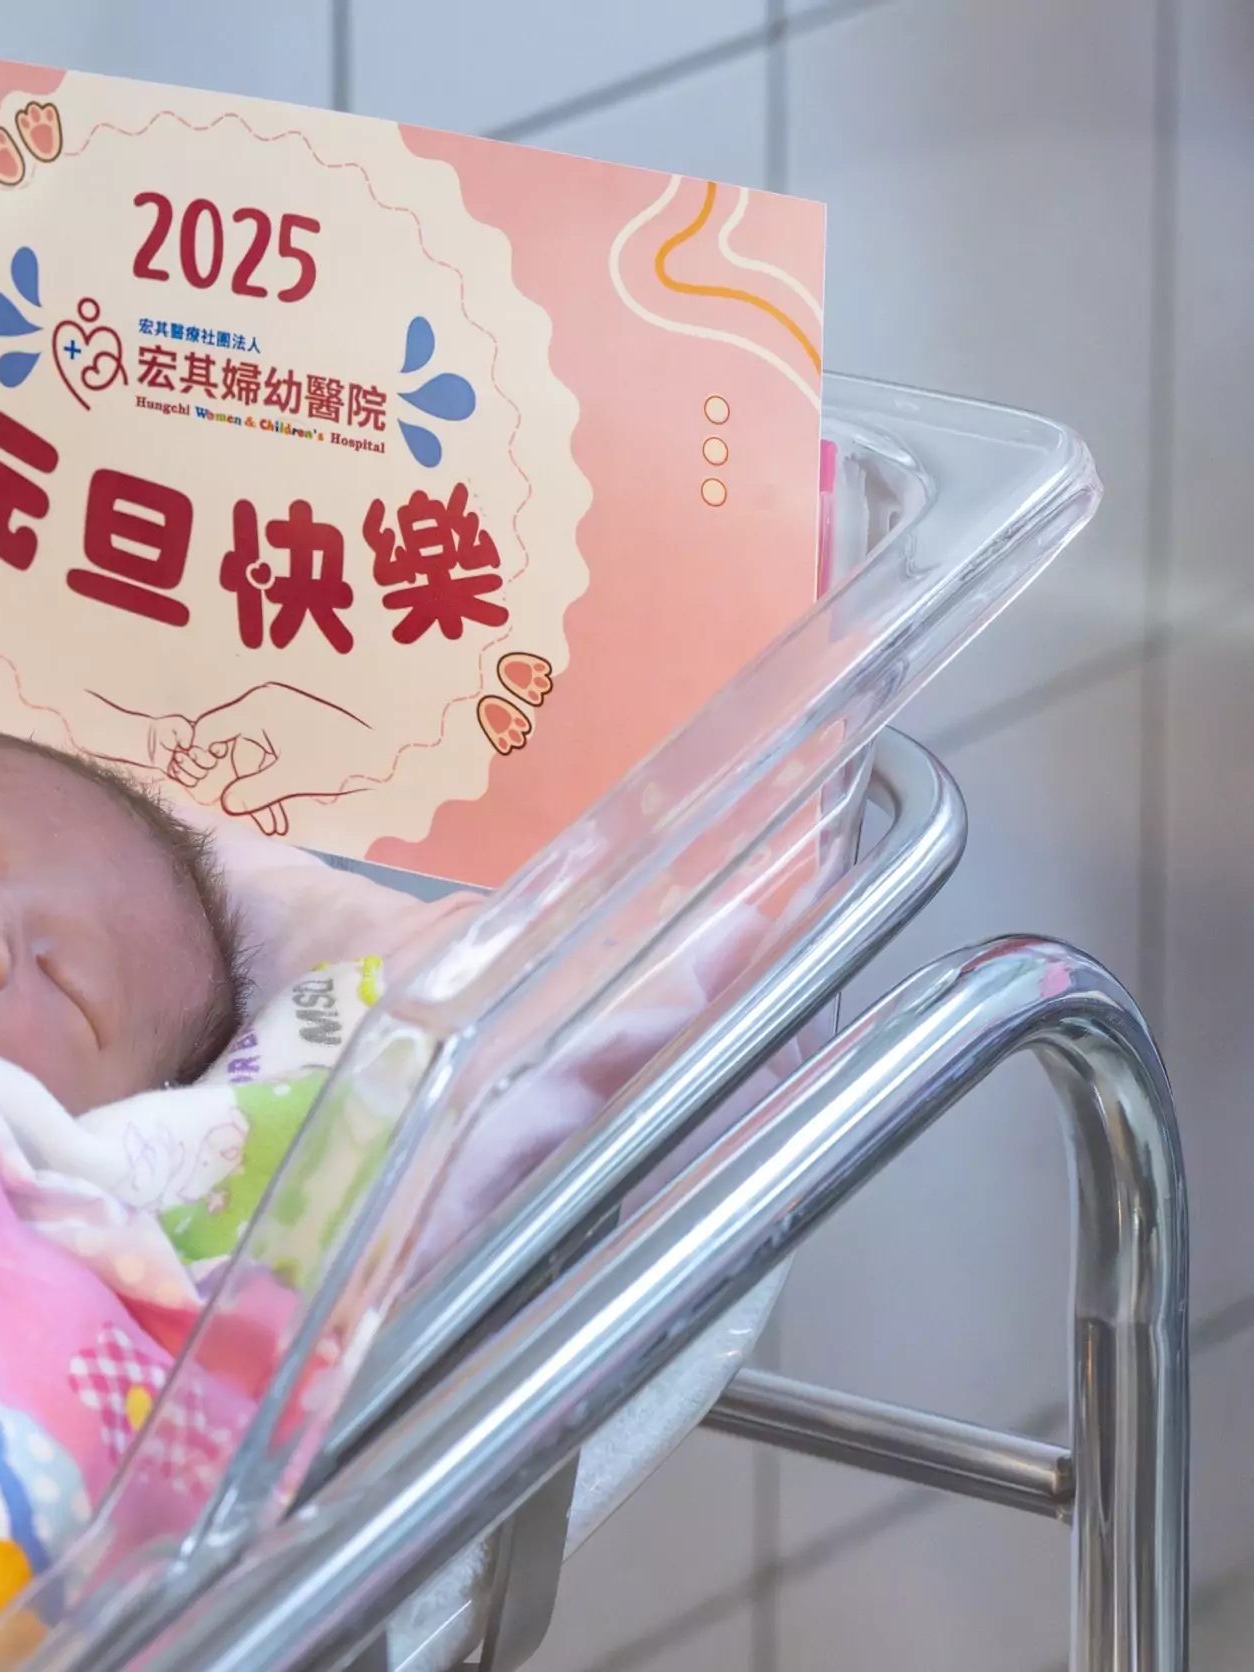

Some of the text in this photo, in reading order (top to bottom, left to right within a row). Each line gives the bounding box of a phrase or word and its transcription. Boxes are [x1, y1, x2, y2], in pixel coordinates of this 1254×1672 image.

[133, 191, 321, 303] 2025
[138, 317, 261, 354] 宏其醫療社團法人
[137, 345, 387, 432] 宏其婦幼醫院
[135, 396, 386, 454] Hungchi Women & Children's Hospital
